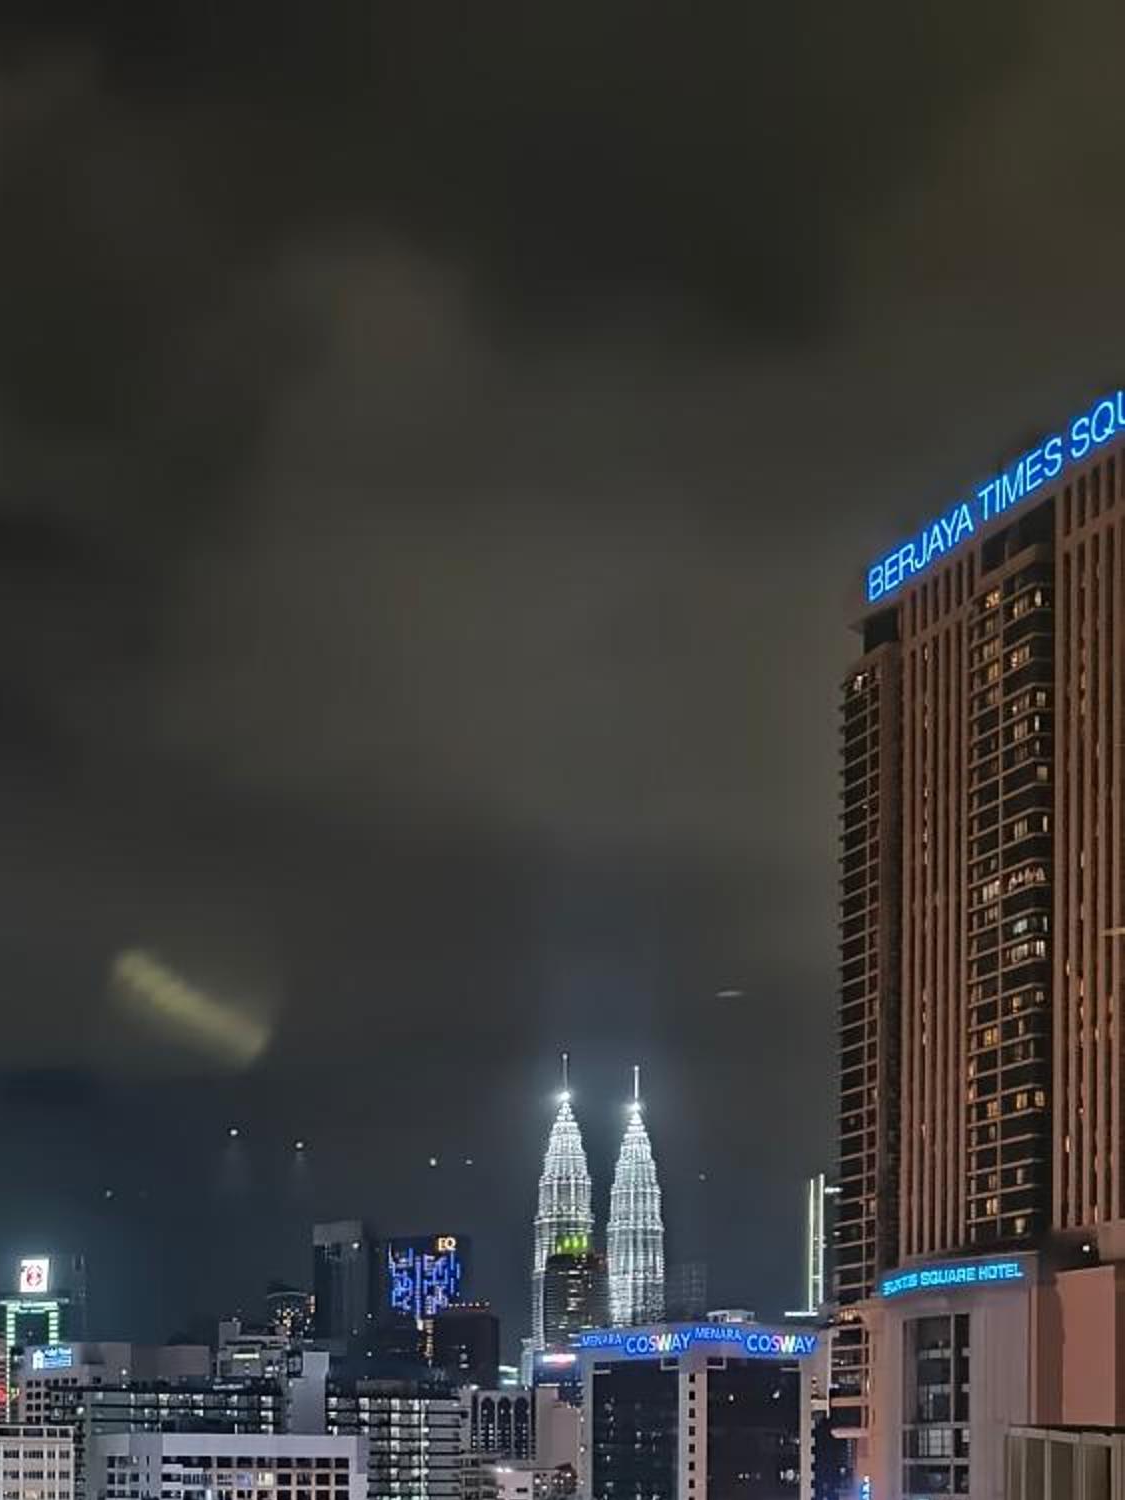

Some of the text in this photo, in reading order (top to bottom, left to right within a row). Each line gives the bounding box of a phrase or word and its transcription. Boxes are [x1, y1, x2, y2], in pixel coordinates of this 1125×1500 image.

[868, 502, 974, 602] BERJAYA
[978, 437, 1062, 521] TIMES
[920, 1267, 976, 1285] SQUARE
[978, 1263, 1024, 1281] HOTEL
[626, 1331, 691, 1353] COSWAY
[746, 1333, 815, 1353] COSWAY
